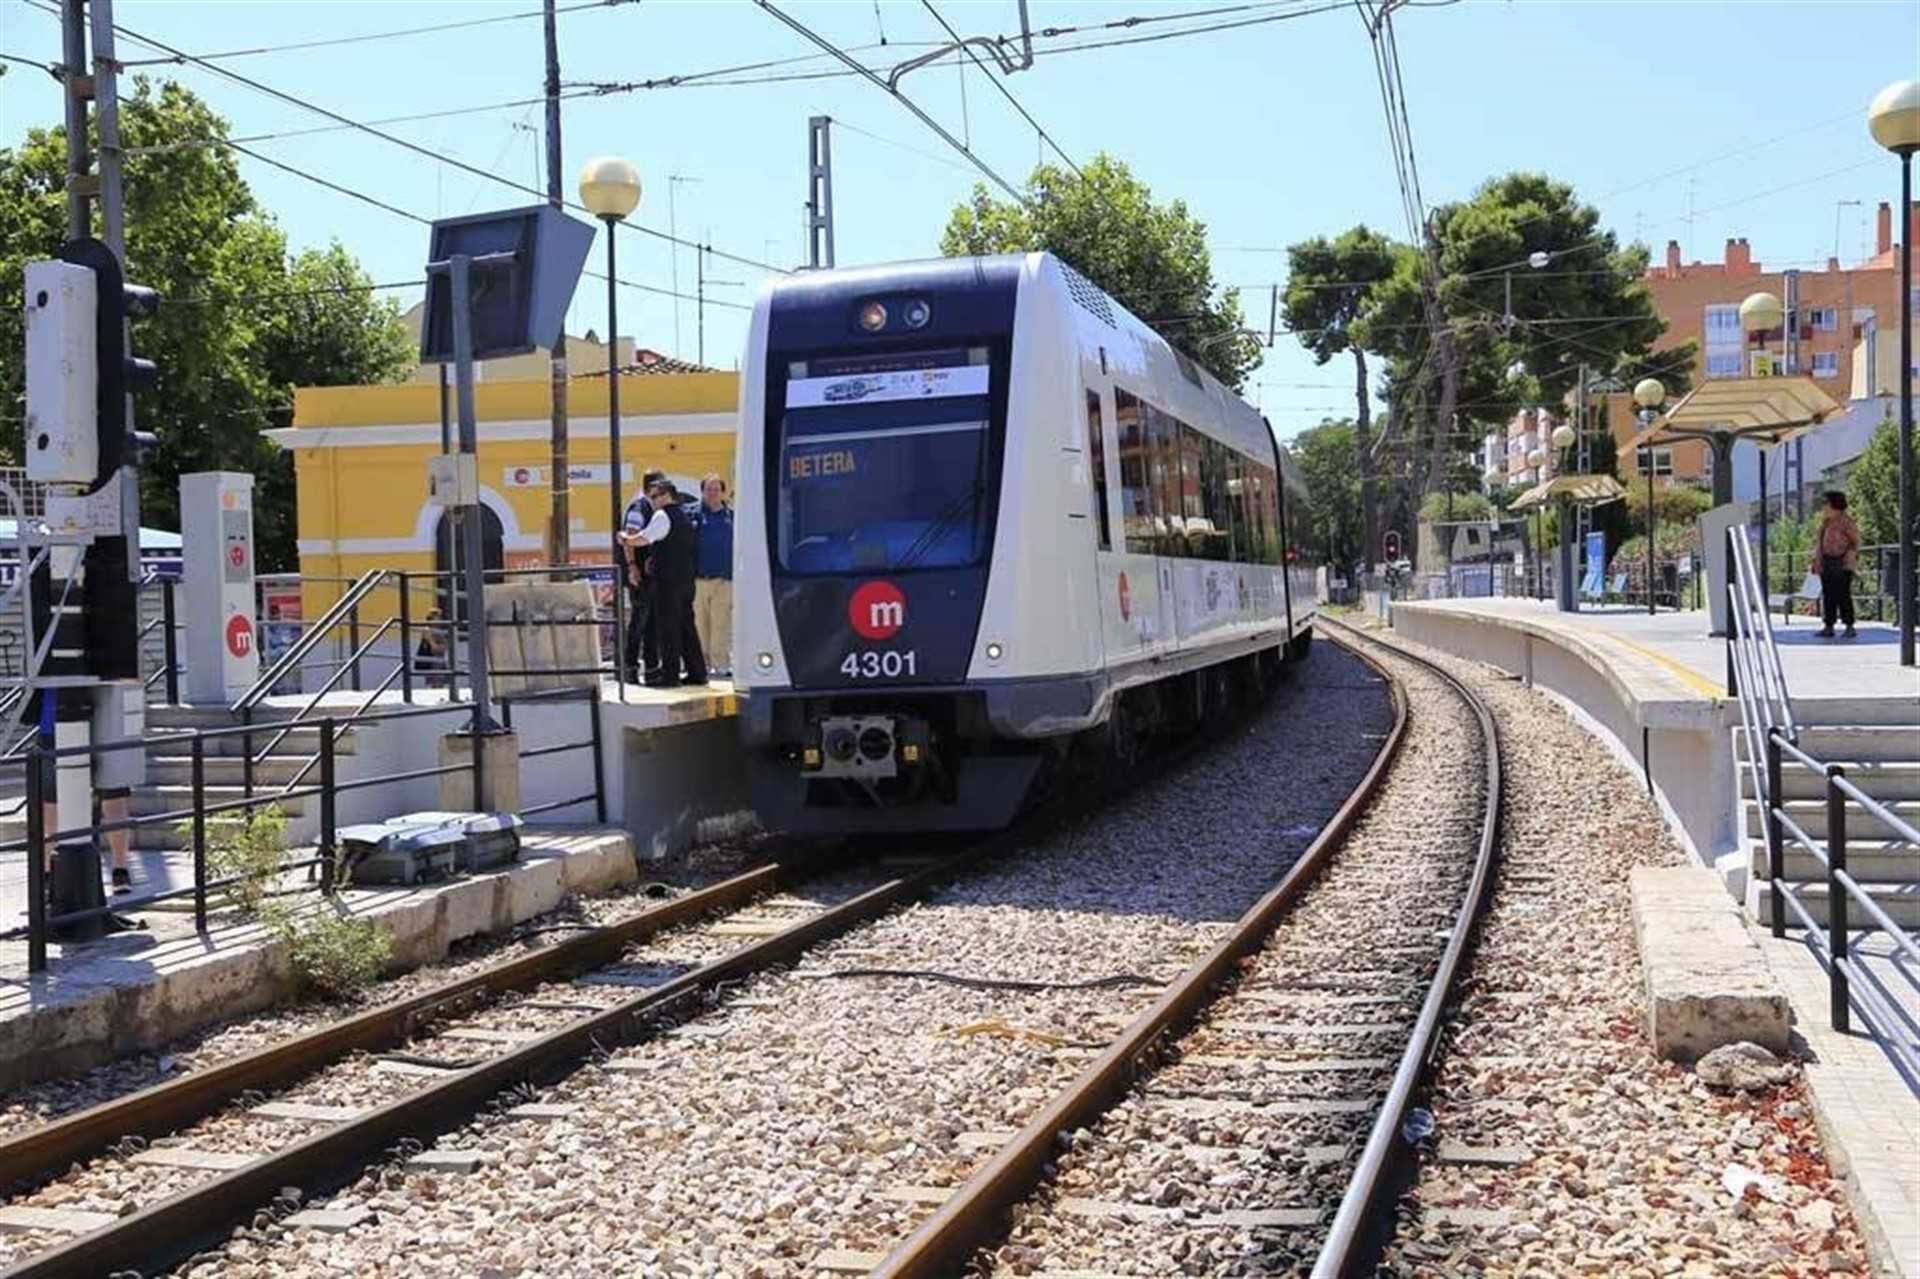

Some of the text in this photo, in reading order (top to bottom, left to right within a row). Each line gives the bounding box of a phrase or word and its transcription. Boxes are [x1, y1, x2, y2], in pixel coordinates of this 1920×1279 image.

[790, 450, 855, 478] BETERA
[871, 601, 903, 627] m
[840, 650, 916, 678] 4301
